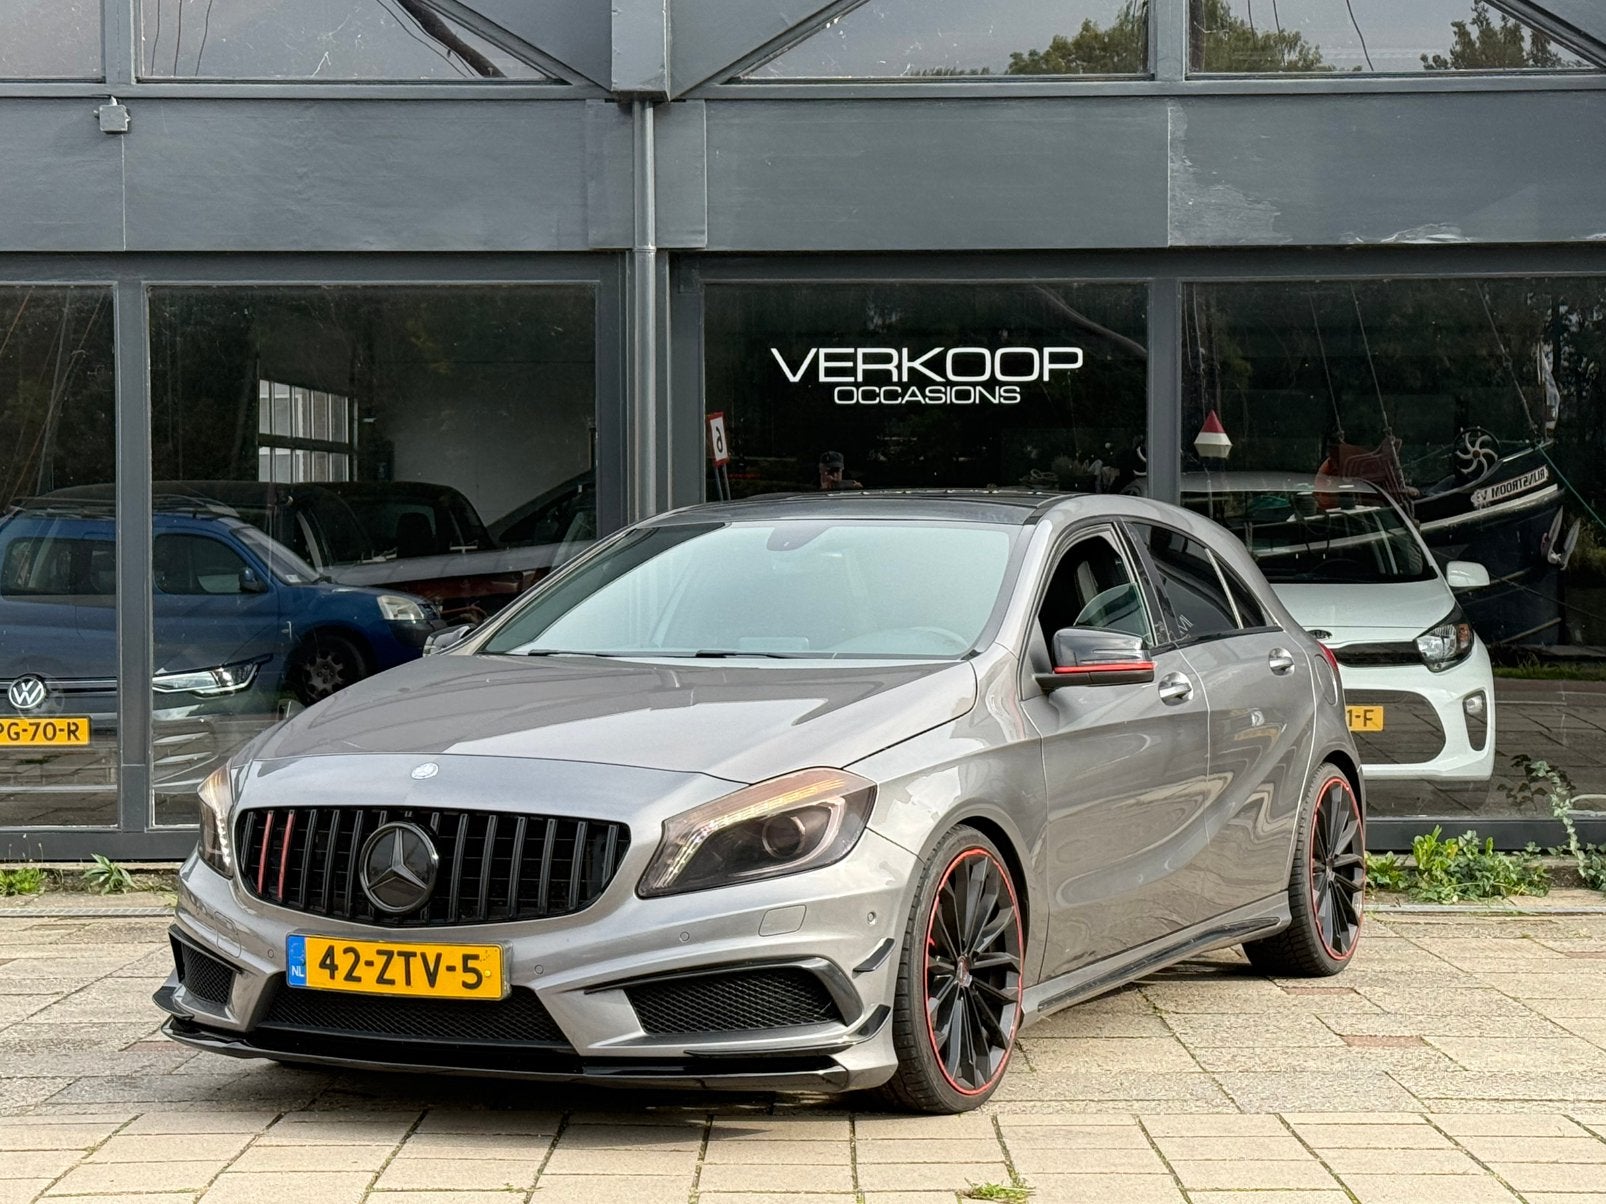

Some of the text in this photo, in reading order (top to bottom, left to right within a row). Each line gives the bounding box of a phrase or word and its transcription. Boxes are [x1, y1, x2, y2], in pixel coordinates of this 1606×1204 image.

[770, 347, 1083, 382] VERKOOP
[834, 386, 1020, 405] OCCASIONS
[291, 944, 483, 990] NL 42-ZTV-5
